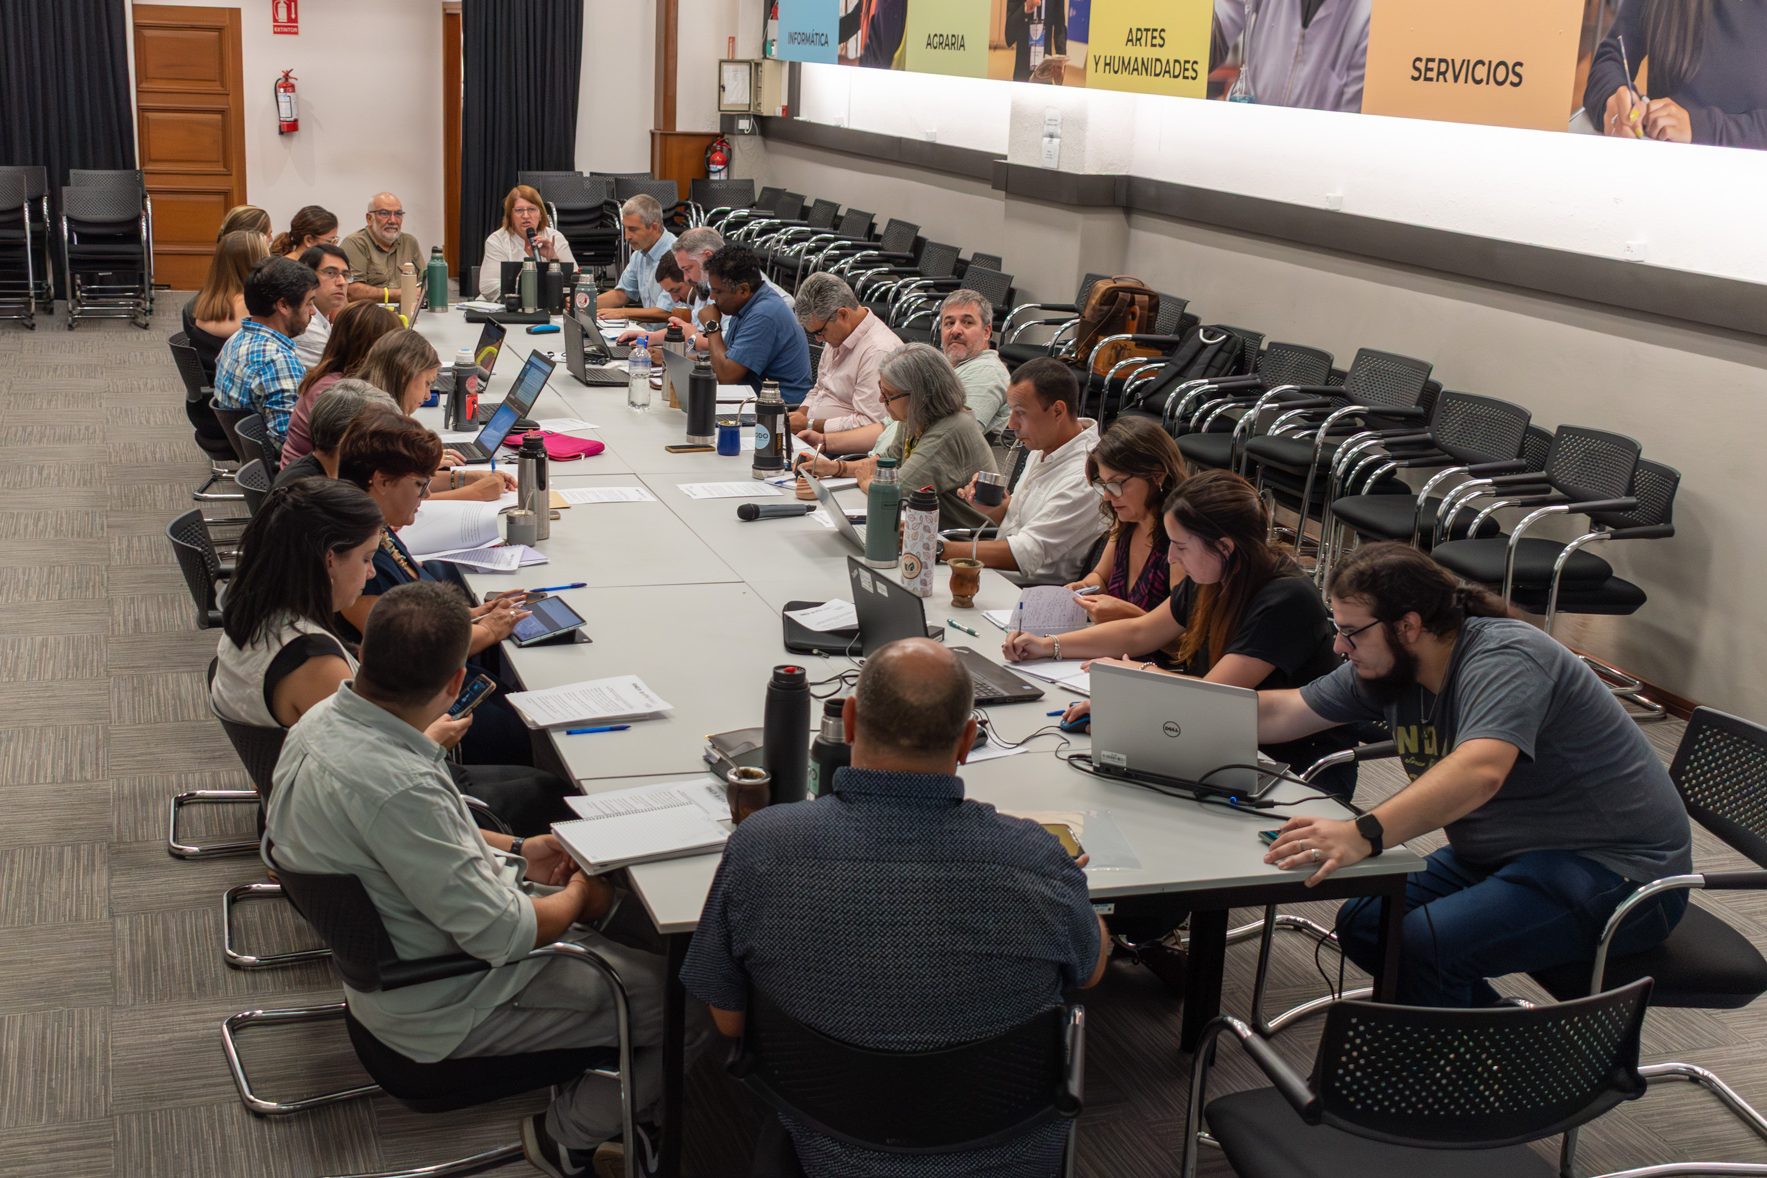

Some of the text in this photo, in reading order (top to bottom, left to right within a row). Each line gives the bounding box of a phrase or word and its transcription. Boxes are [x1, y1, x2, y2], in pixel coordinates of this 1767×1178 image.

[787, 29, 829, 48] INFORMÁTICA
[925, 33, 966, 51] AGRARIA
[1125, 27, 1166, 48] ARTES
[1093, 55, 1199, 81] Y HUMANIDADES
[1410, 56, 1524, 88] SERVICIOS
